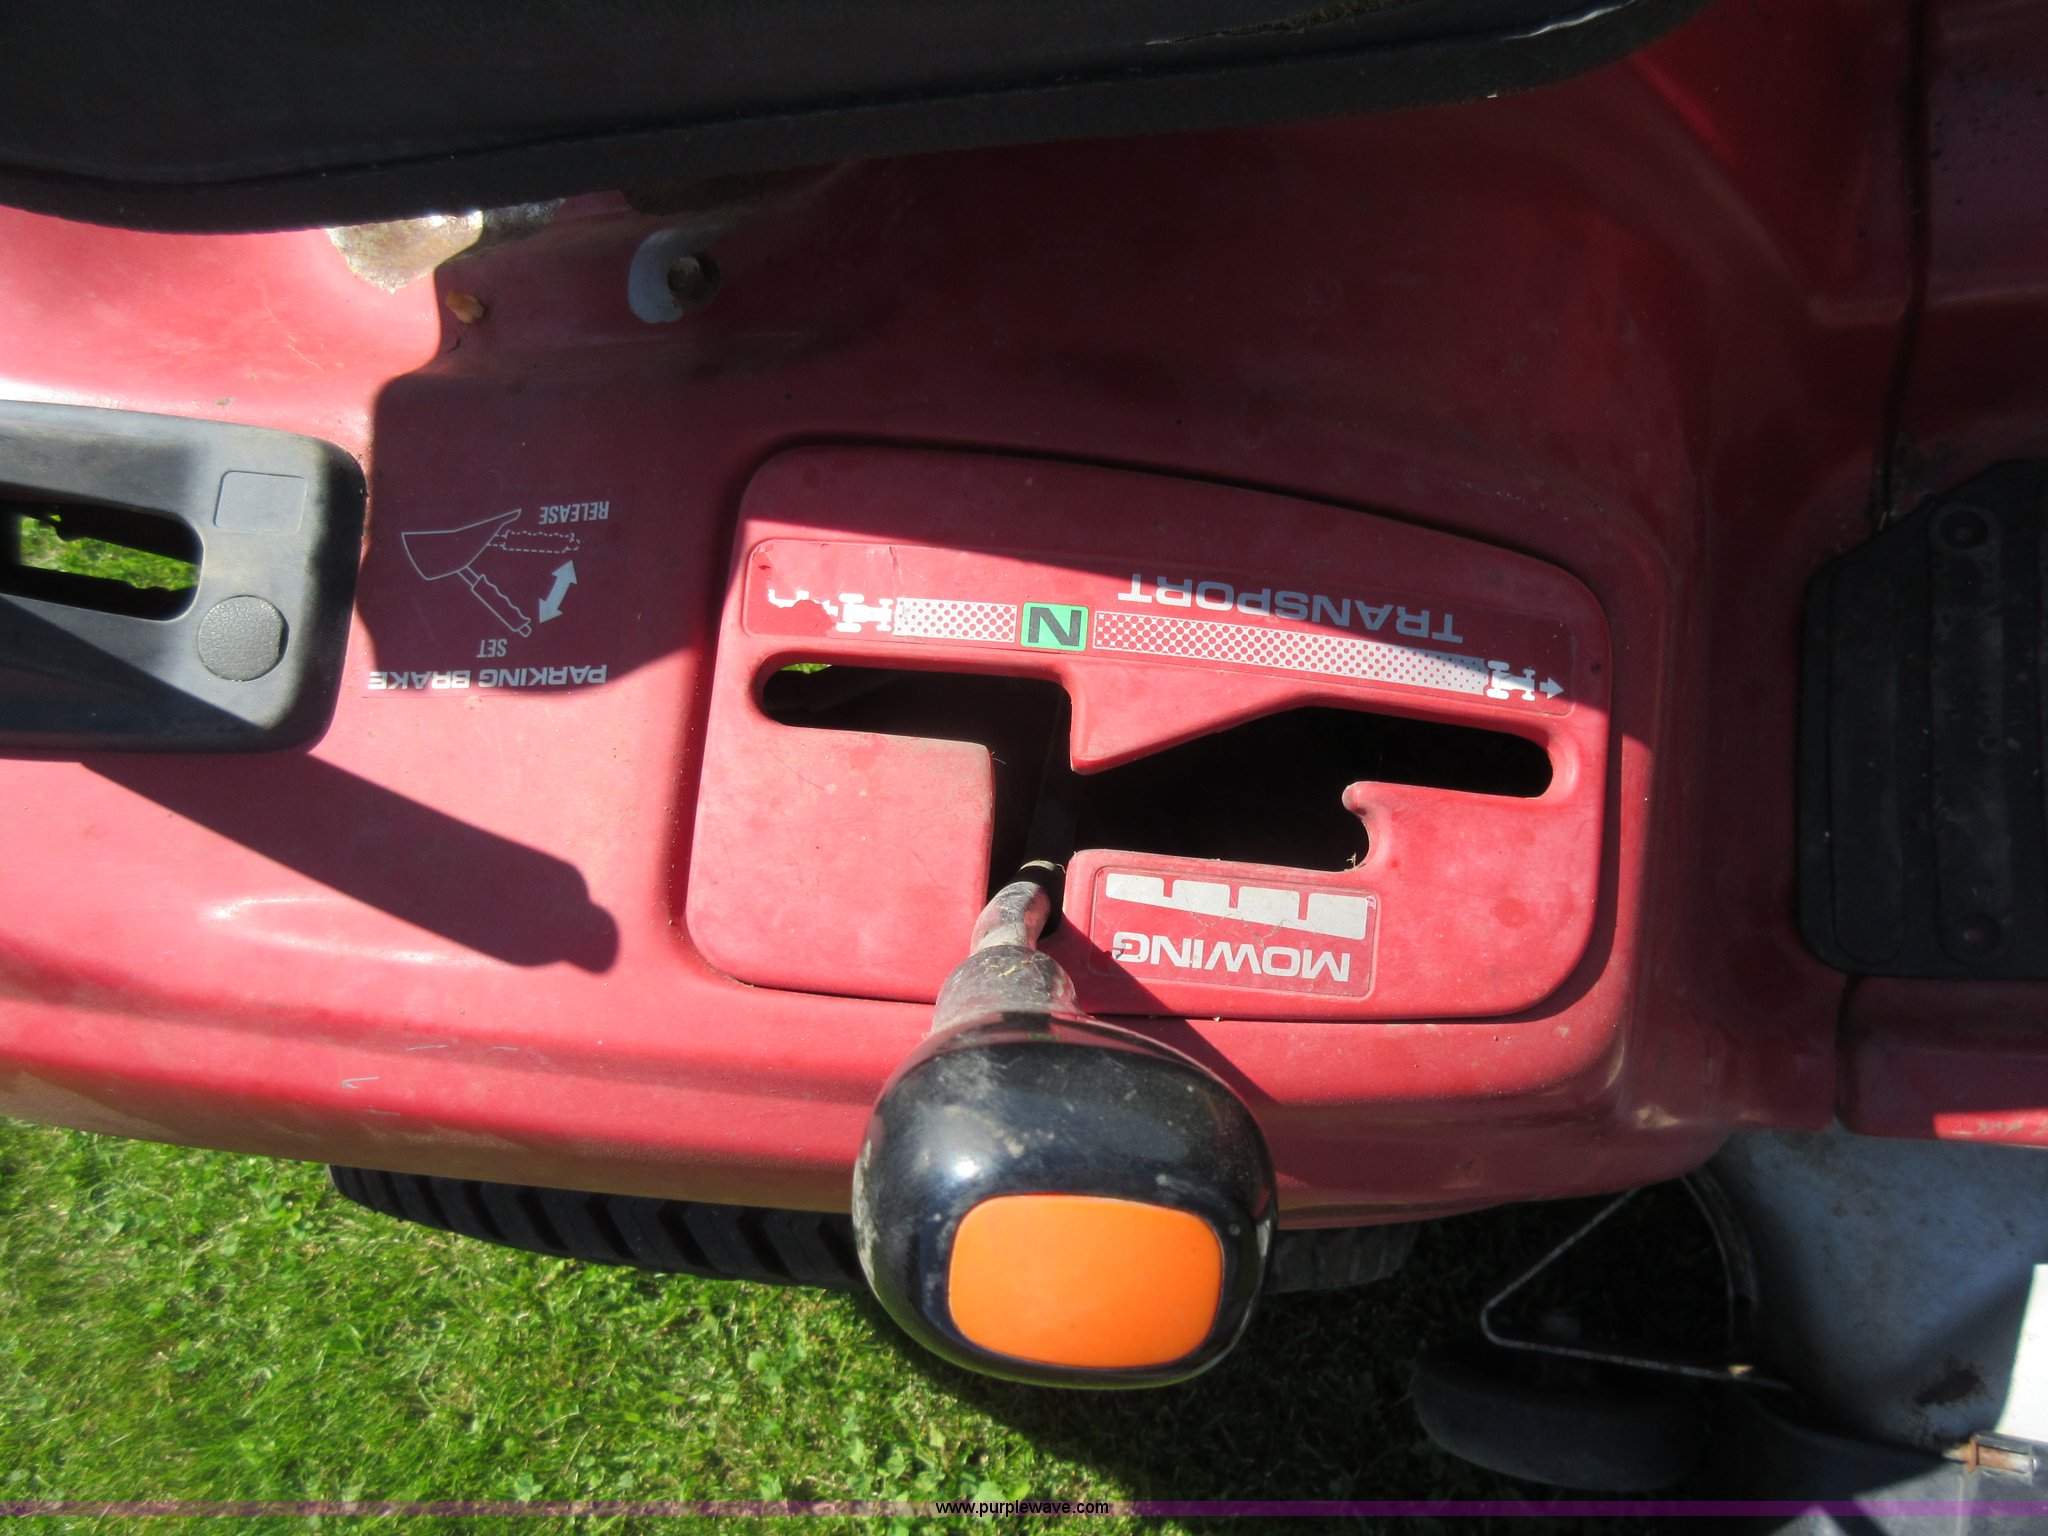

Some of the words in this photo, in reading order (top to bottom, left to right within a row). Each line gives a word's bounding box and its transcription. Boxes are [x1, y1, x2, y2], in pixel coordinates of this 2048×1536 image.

[538, 501, 610, 525] RELEASE
[1117, 573, 1464, 643] TRANSPORT
[1027, 606, 1083, 647] N
[476, 638, 508, 658] SET
[367, 670, 471, 690] BRAKE
[478, 664, 608, 688] PARKING
[1111, 931, 1351, 983] MOWING
